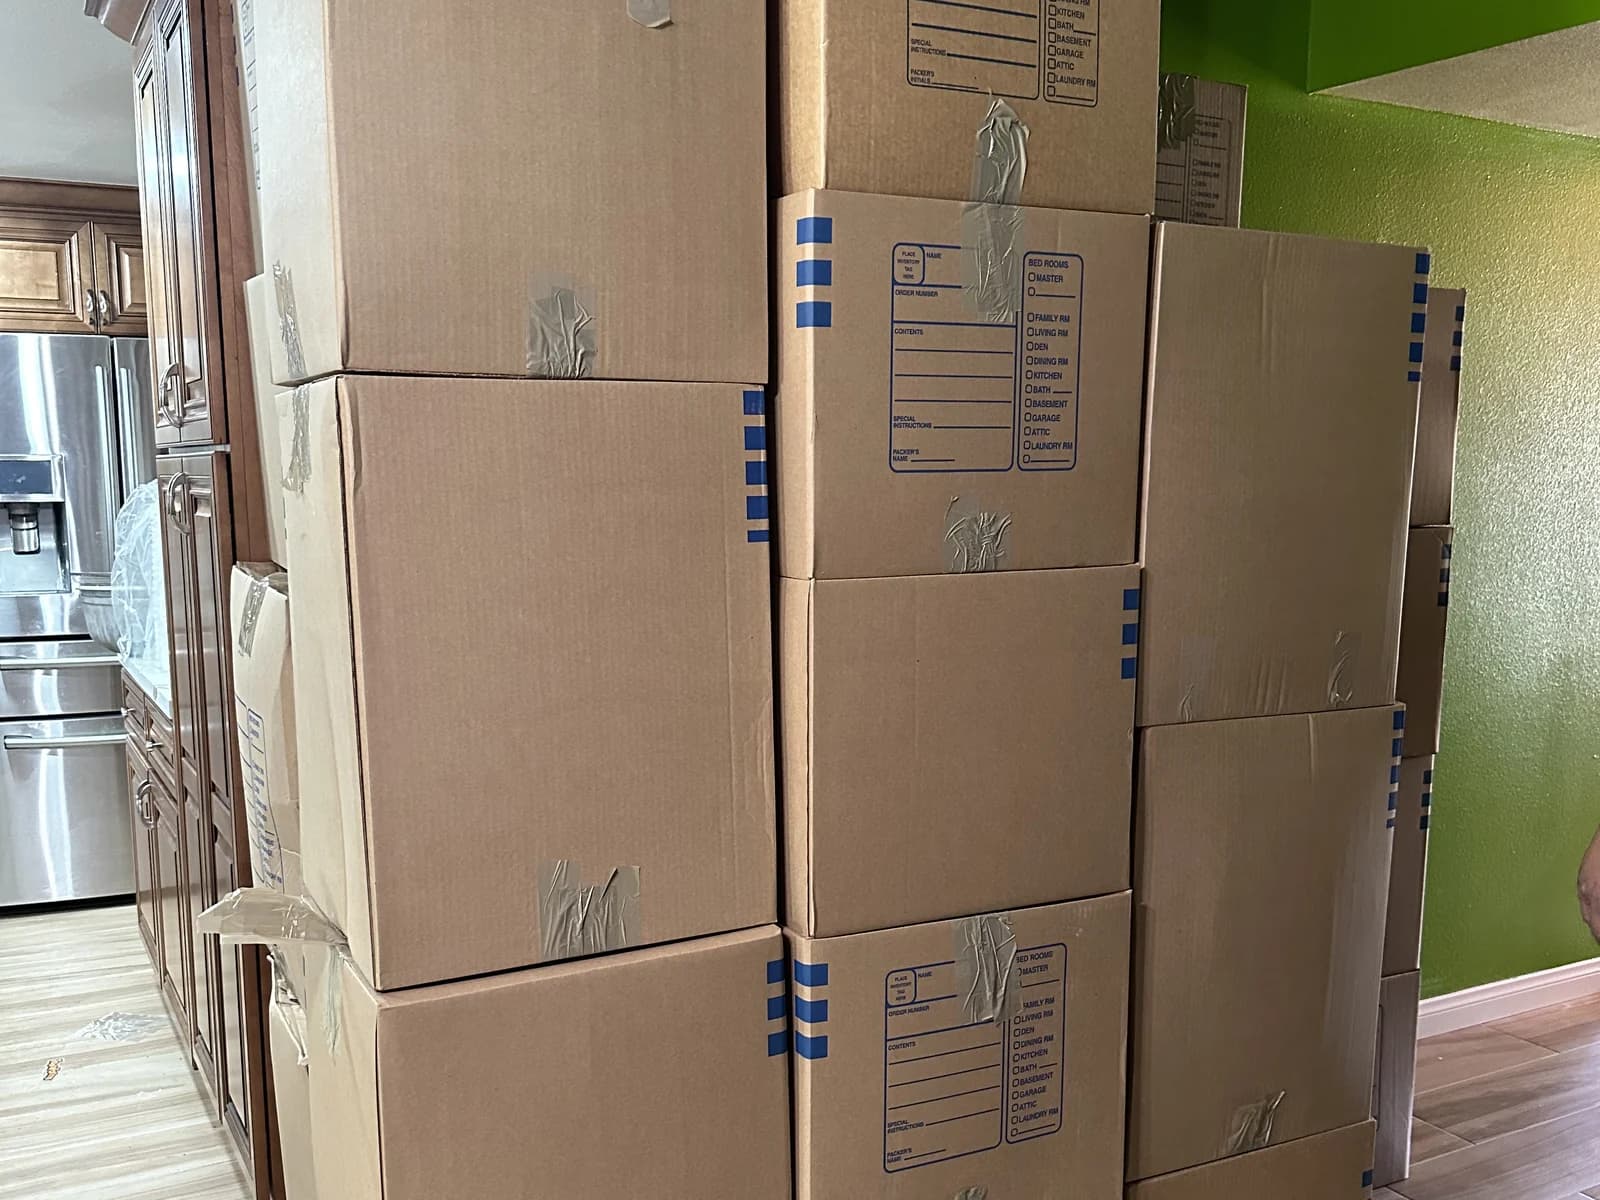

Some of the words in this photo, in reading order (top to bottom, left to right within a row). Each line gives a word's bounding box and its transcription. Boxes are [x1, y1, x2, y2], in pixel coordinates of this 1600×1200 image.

[1056, 8, 1085, 19] KITCHEN
[1057, 21, 1074, 30] BATH
[1057, 34, 1091, 47] BASEMENT
[1057, 48, 1084, 58] GARAGE
[1056, 61, 1074, 70] ATTIC
[1056, 75, 1085, 86] LAUNDRY
[1086, 78, 1096, 88] RM
[1044, 260, 1069, 268] ROOMS
[1036, 274, 1063, 283] MASTER
[1035, 314, 1058, 322] FAMILY
[1035, 328, 1056, 336] LIVING
[1034, 357, 1056, 365] DINING
[1031, 951, 1053, 960] ROOMS
[1023, 964, 1048, 975] MASTER
[1045, 997, 1055, 1005] RM
[1022, 1012, 1042, 1023] LIVING
[888, 1041, 916, 1050] CONTENTS
[1021, 1037, 1042, 1048] DINING
[1021, 1048, 1048, 1060] KITCHEN
[1021, 1064, 1037, 1073] BATH
[1020, 1072, 1054, 1085] BASEMENT
[1020, 1086, 1046, 1098] GARAGE
[1020, 1101, 1037, 1111] ATTIC
[1019, 1111, 1047, 1123] LAUNDRY
[1049, 1107, 1059, 1116] RM
